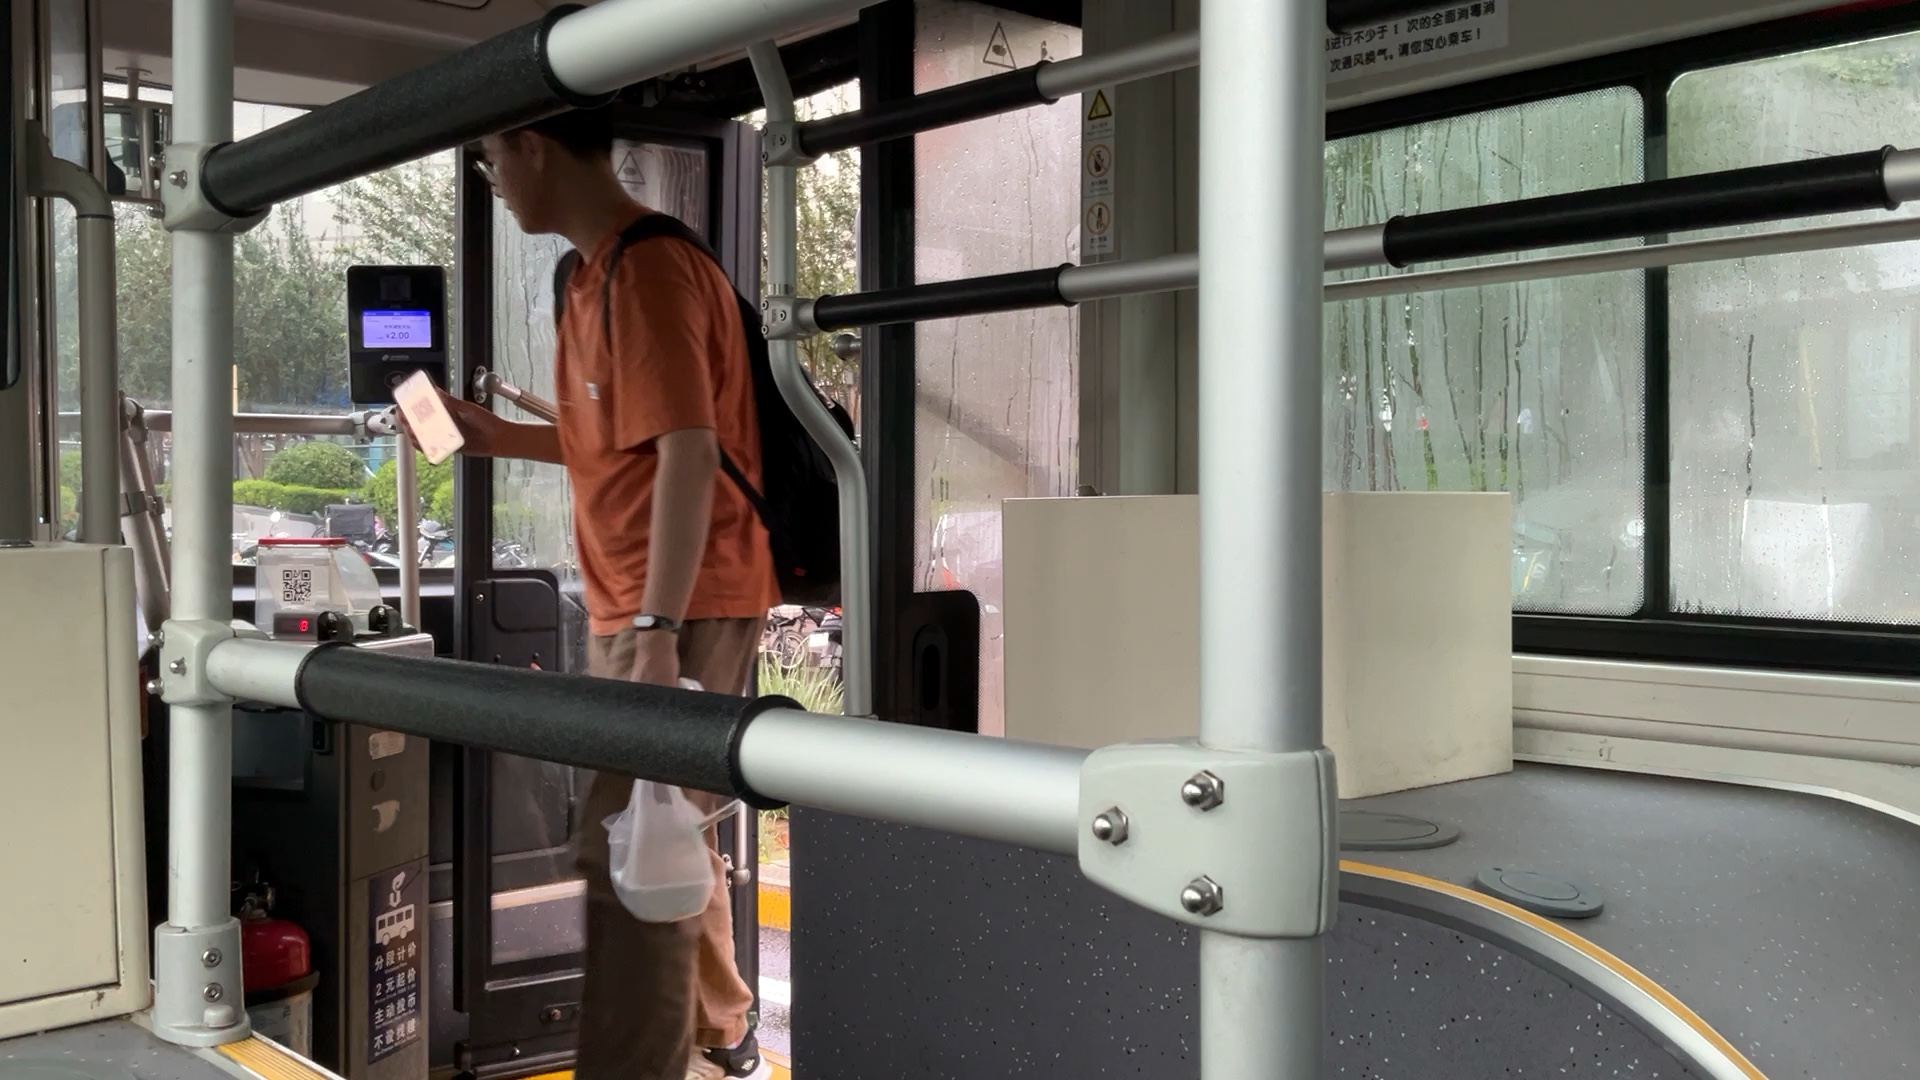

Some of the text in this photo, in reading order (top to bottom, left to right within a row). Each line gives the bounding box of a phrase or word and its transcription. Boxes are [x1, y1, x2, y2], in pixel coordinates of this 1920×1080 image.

[1407, 0, 1496, 33] 次的全面消毒消
[374, 941, 416, 972] 分段计价
[374, 992, 416, 1025] 主动投币
